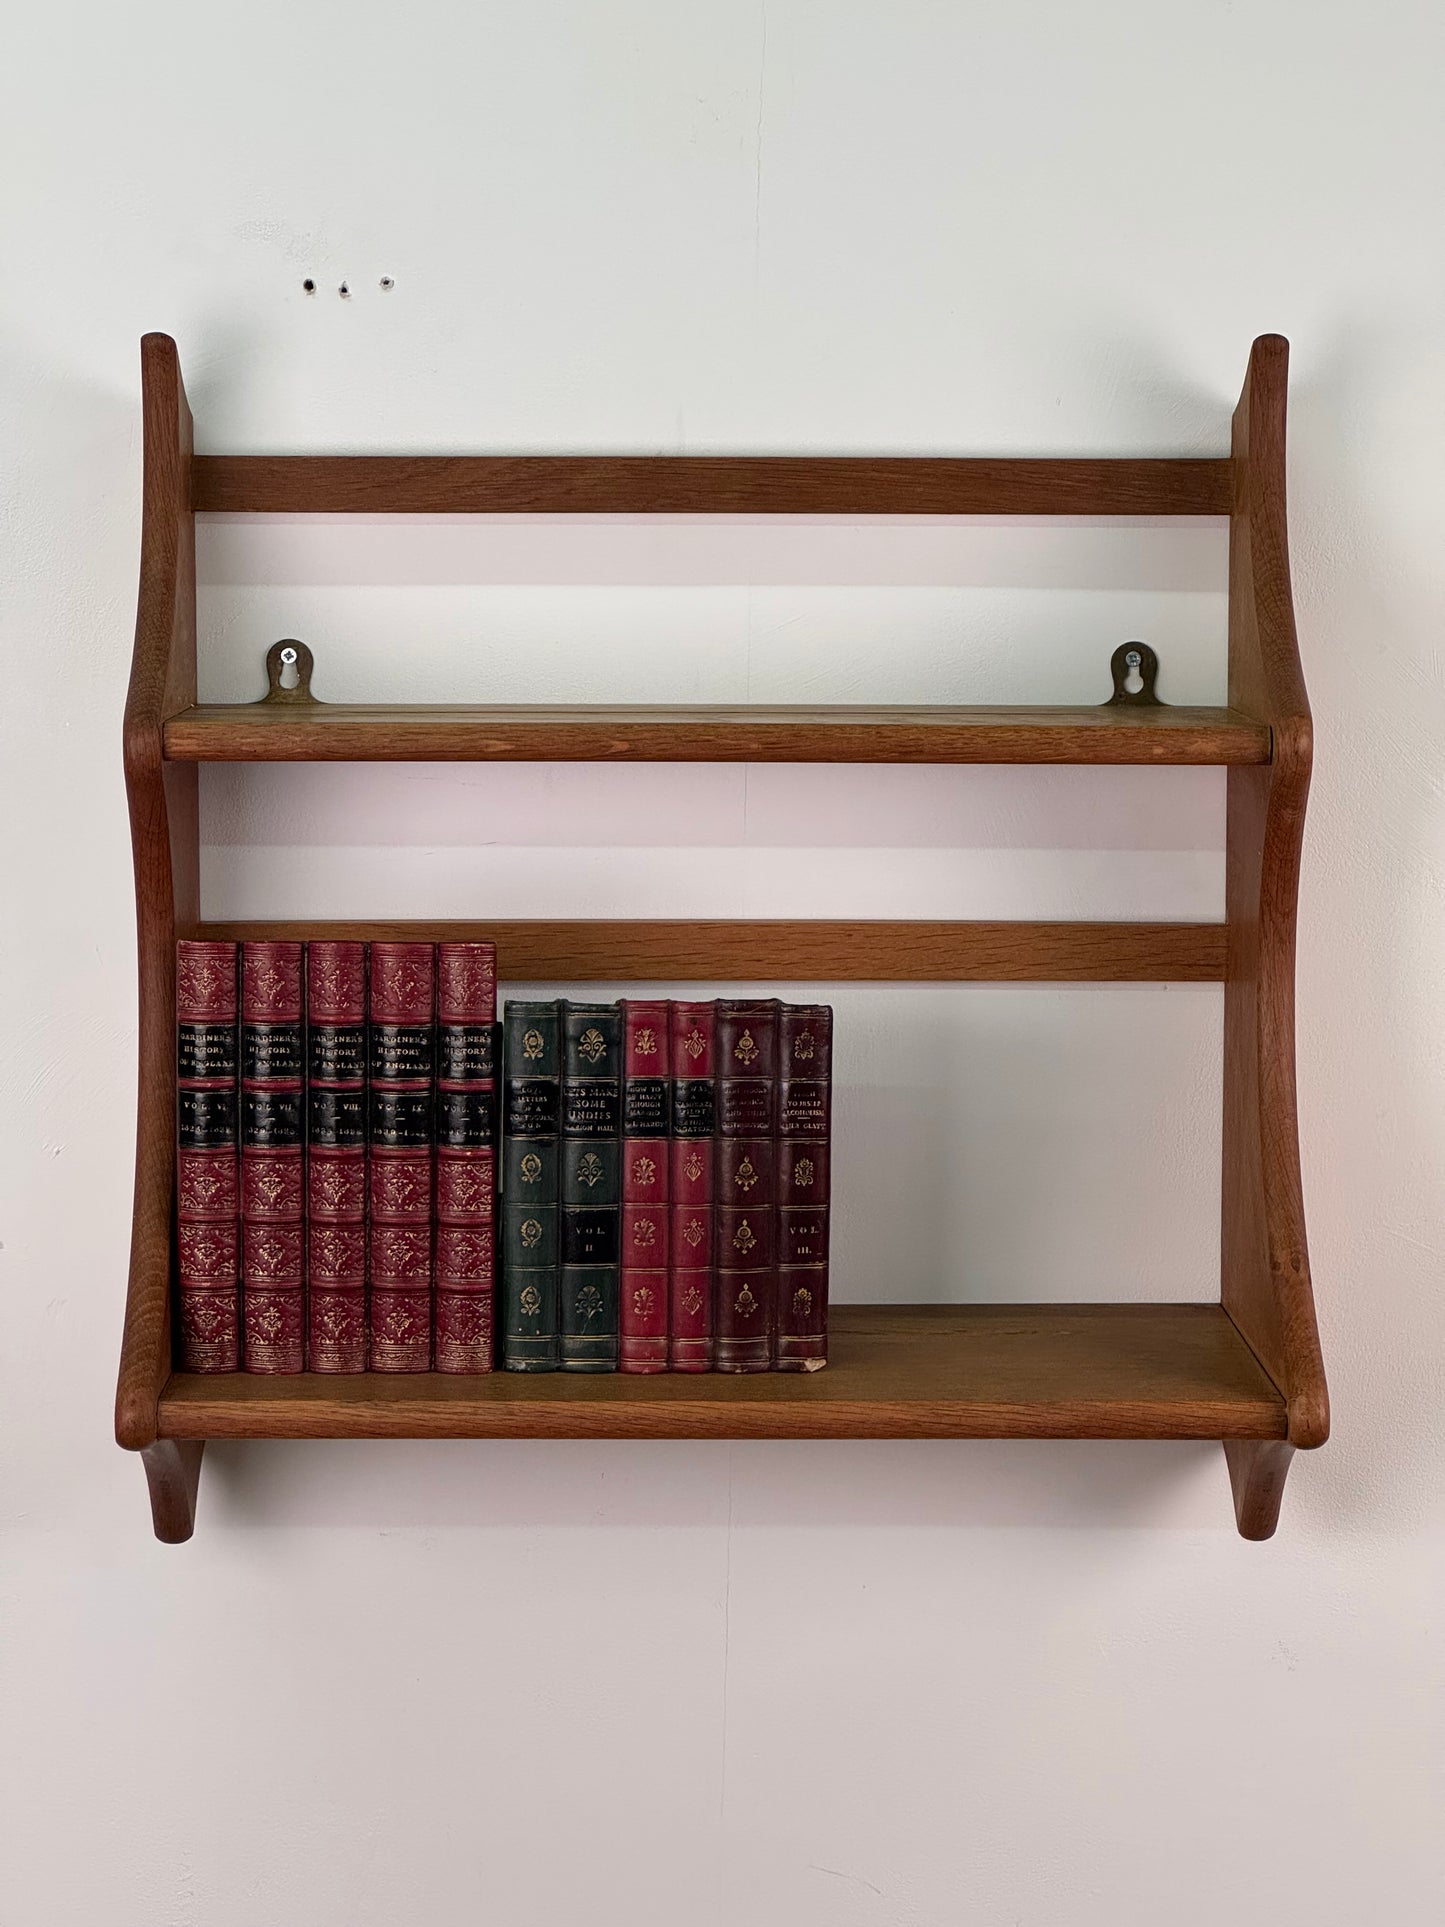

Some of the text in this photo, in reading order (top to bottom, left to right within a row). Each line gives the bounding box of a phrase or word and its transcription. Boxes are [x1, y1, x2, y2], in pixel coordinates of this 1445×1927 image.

[441, 1032, 492, 1043] ARDINER'S
[184, 1046, 224, 1054] HISTORY
[249, 1046, 290, 1054] HISTORY
[315, 1047, 357, 1056] HISTORY
[377, 1047, 420, 1056] HISTORY
[444, 1047, 487, 1055] HISTORY
[191, 1060, 234, 1068] ENGLAND
[257, 1060, 301, 1068] ENGLAND
[322, 1061, 365, 1069] ENGLAND
[385, 1062, 431, 1070] ENGLAND
[452, 1061, 494, 1069] ENGLAND
[590, 1088, 619, 1098] MAKE
[517, 1096, 548, 1104] LETTERS
[575, 1099, 606, 1109] SOME
[343, 1103, 361, 1111] VIII.
[630, 1101, 662, 1109] THOUGH
[568, 1110, 611, 1121] UNDIES
[629, 1109, 662, 1117] MARED
[679, 1108, 707, 1116] PILOT
[597, 1124, 616, 1132] HALL
